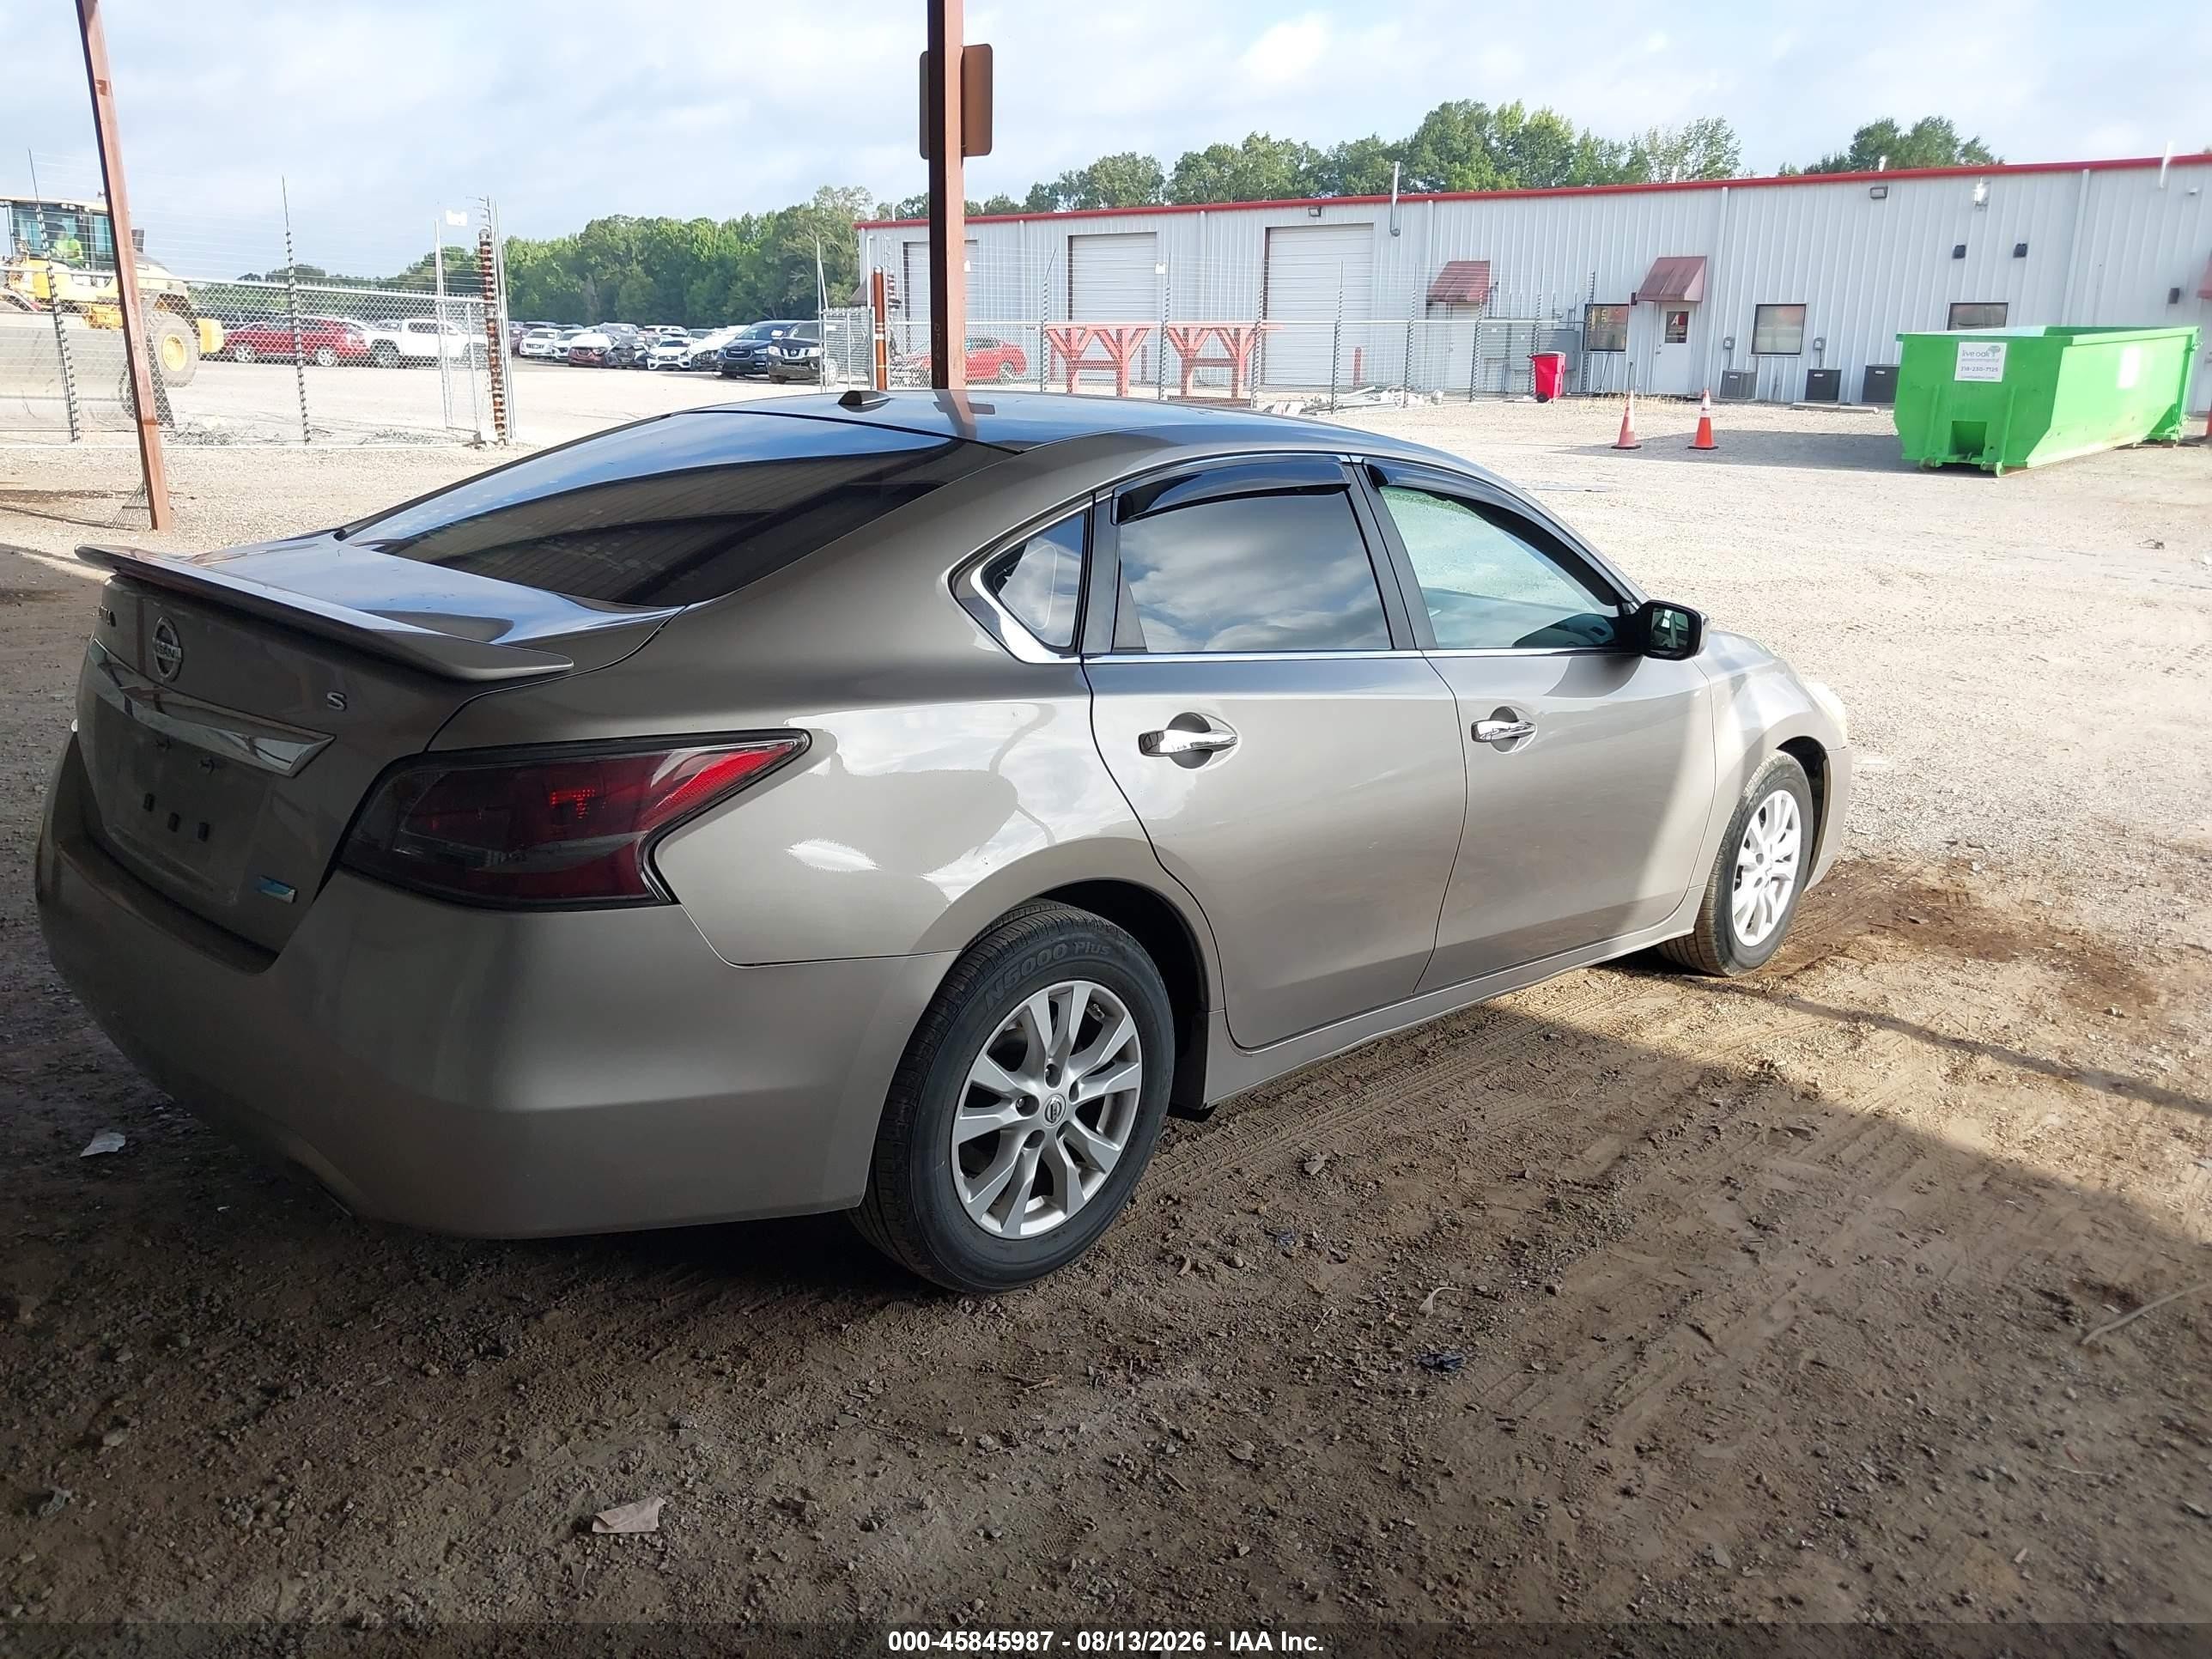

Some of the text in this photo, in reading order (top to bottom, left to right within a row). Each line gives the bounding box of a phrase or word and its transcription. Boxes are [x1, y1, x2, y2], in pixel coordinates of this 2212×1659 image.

[326, 691, 347, 712] S
[985, 941, 1111, 1011] N5000 Plus
